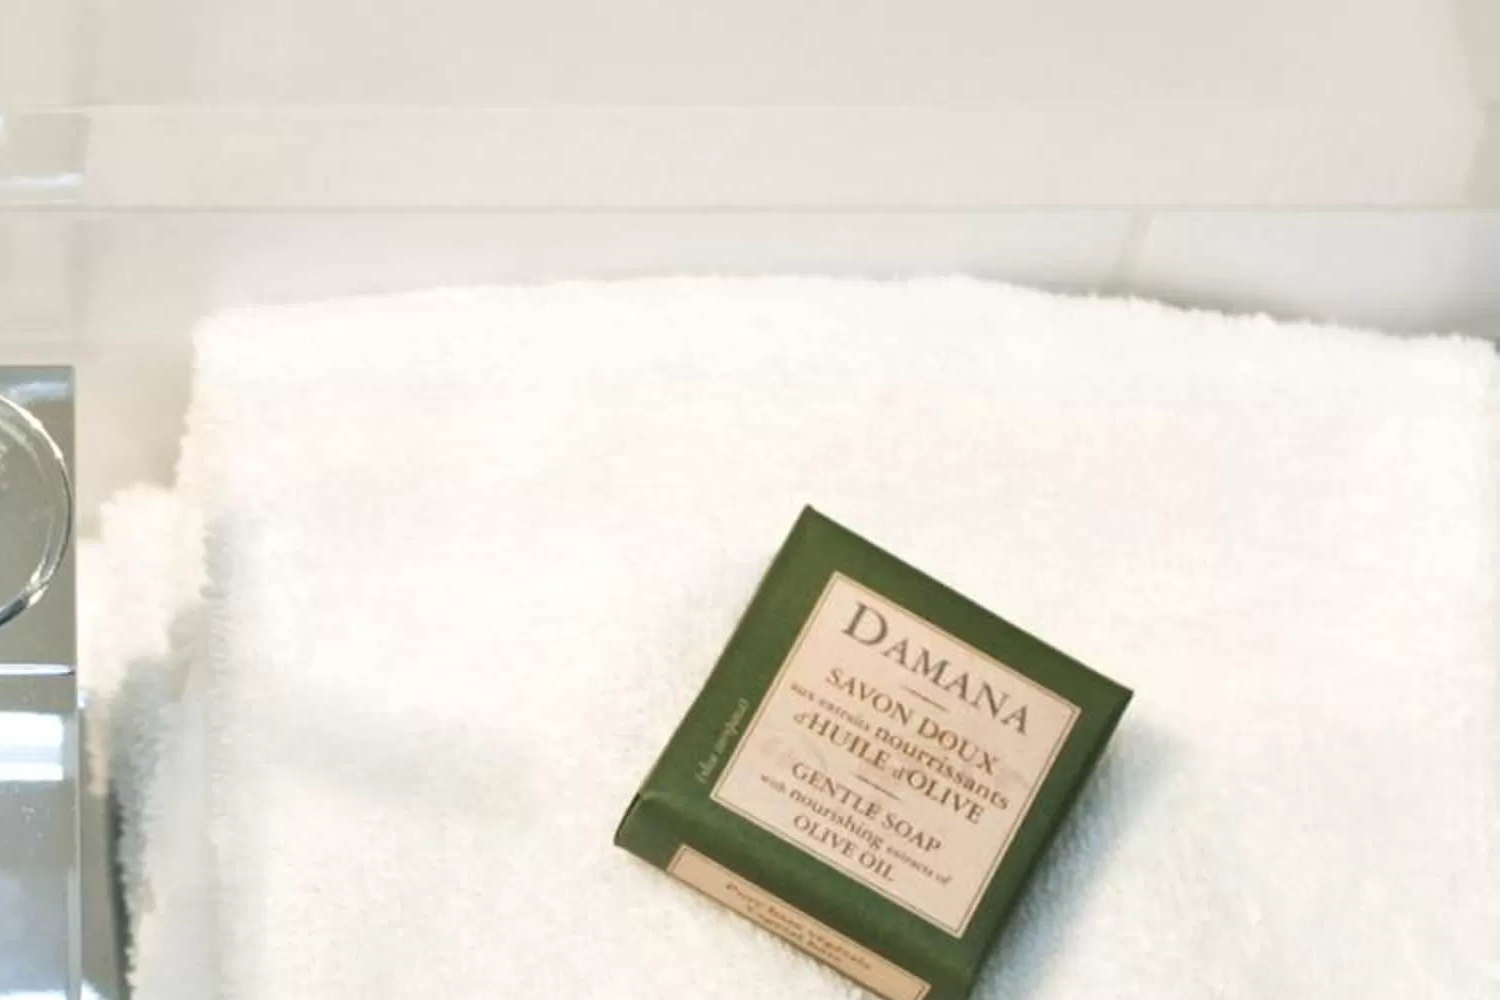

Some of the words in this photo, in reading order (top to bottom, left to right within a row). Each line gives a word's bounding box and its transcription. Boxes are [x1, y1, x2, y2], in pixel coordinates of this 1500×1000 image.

[841, 601, 1028, 736] DAMANA
[824, 668, 914, 727] SAVON
[916, 715, 1000, 777] DOUX
[759, 773, 787, 795] with
[788, 788, 885, 851] nourishing
[791, 761, 881, 821] GENTLE
[881, 811, 942, 853] SOAP
[873, 726, 1010, 811] nourrissants
[792, 814, 858, 858] OLIVE
[857, 850, 894, 882] OIL
